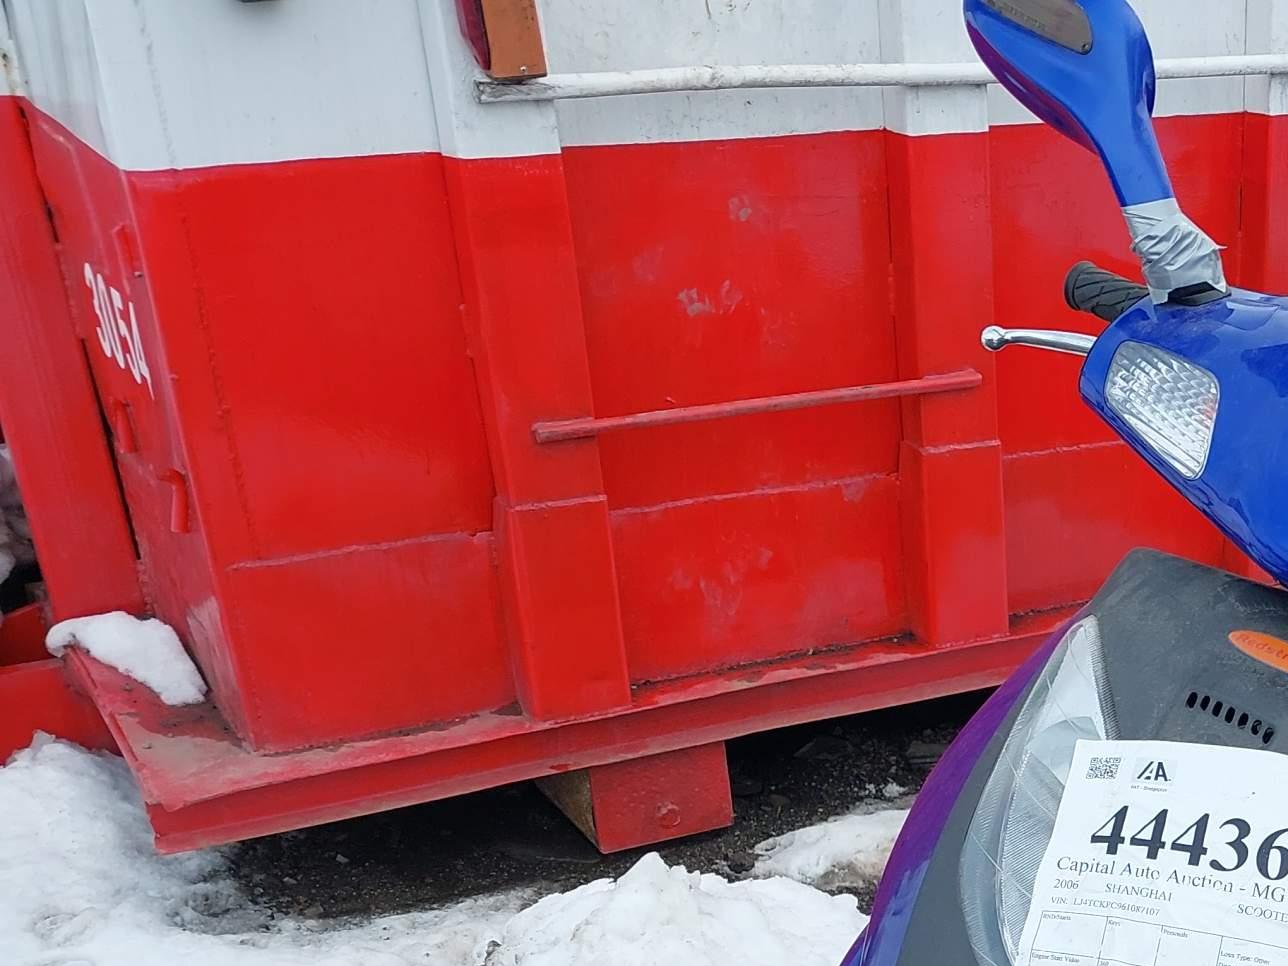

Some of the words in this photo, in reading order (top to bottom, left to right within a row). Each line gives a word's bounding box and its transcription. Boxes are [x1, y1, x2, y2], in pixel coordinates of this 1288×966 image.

[83, 262, 155, 400] 3054
[1053, 878, 1080, 890] 2006
[1105, 883, 1172, 902] SHANGHAI
[1056, 856, 1115, 878] Capital
[1119, 862, 1161, 881] Auto
[1166, 869, 1234, 894] Auction
[1252, 882, 1286, 904] MG
[1051, 896, 1068, 905] VIN:
[1220, 950, 1235, 959] Loss
[1236, 953, 1252, 962] Type:
